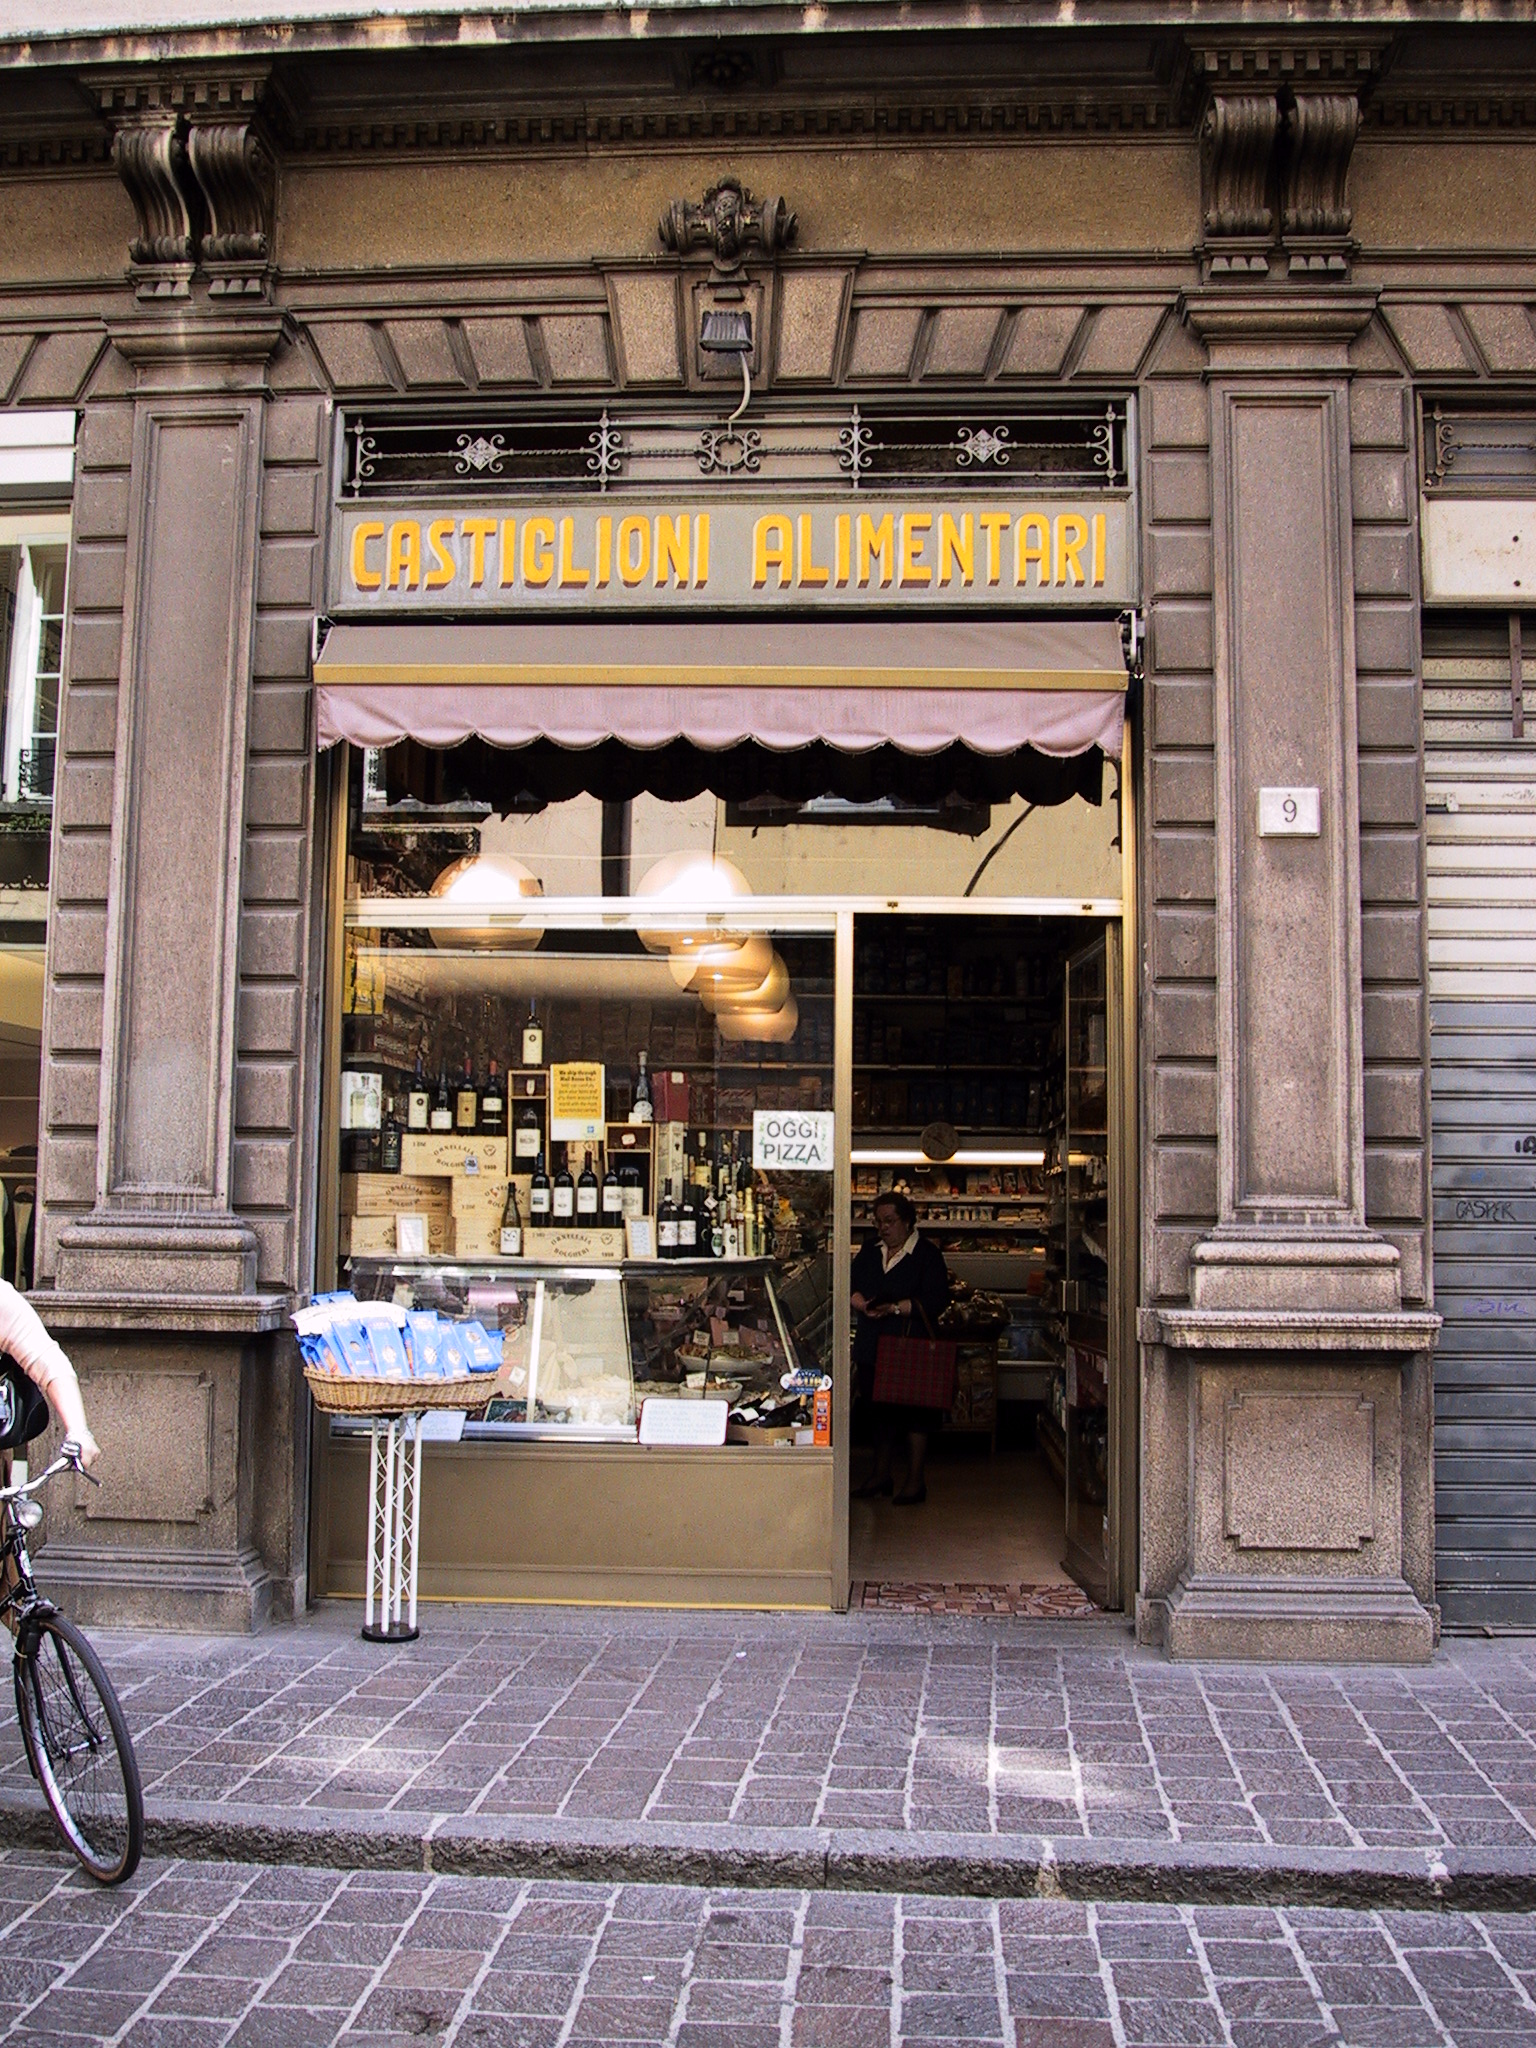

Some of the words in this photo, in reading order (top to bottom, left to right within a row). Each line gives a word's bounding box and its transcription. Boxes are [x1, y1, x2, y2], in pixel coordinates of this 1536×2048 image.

[350, 513, 710, 592] CASTIGLIONI
[752, 512, 1106, 589] ALIMENTARI
[1283, 799, 1297, 823] 9
[767, 1121, 818, 1139] OGGI
[764, 1144, 822, 1161] PIZZA
